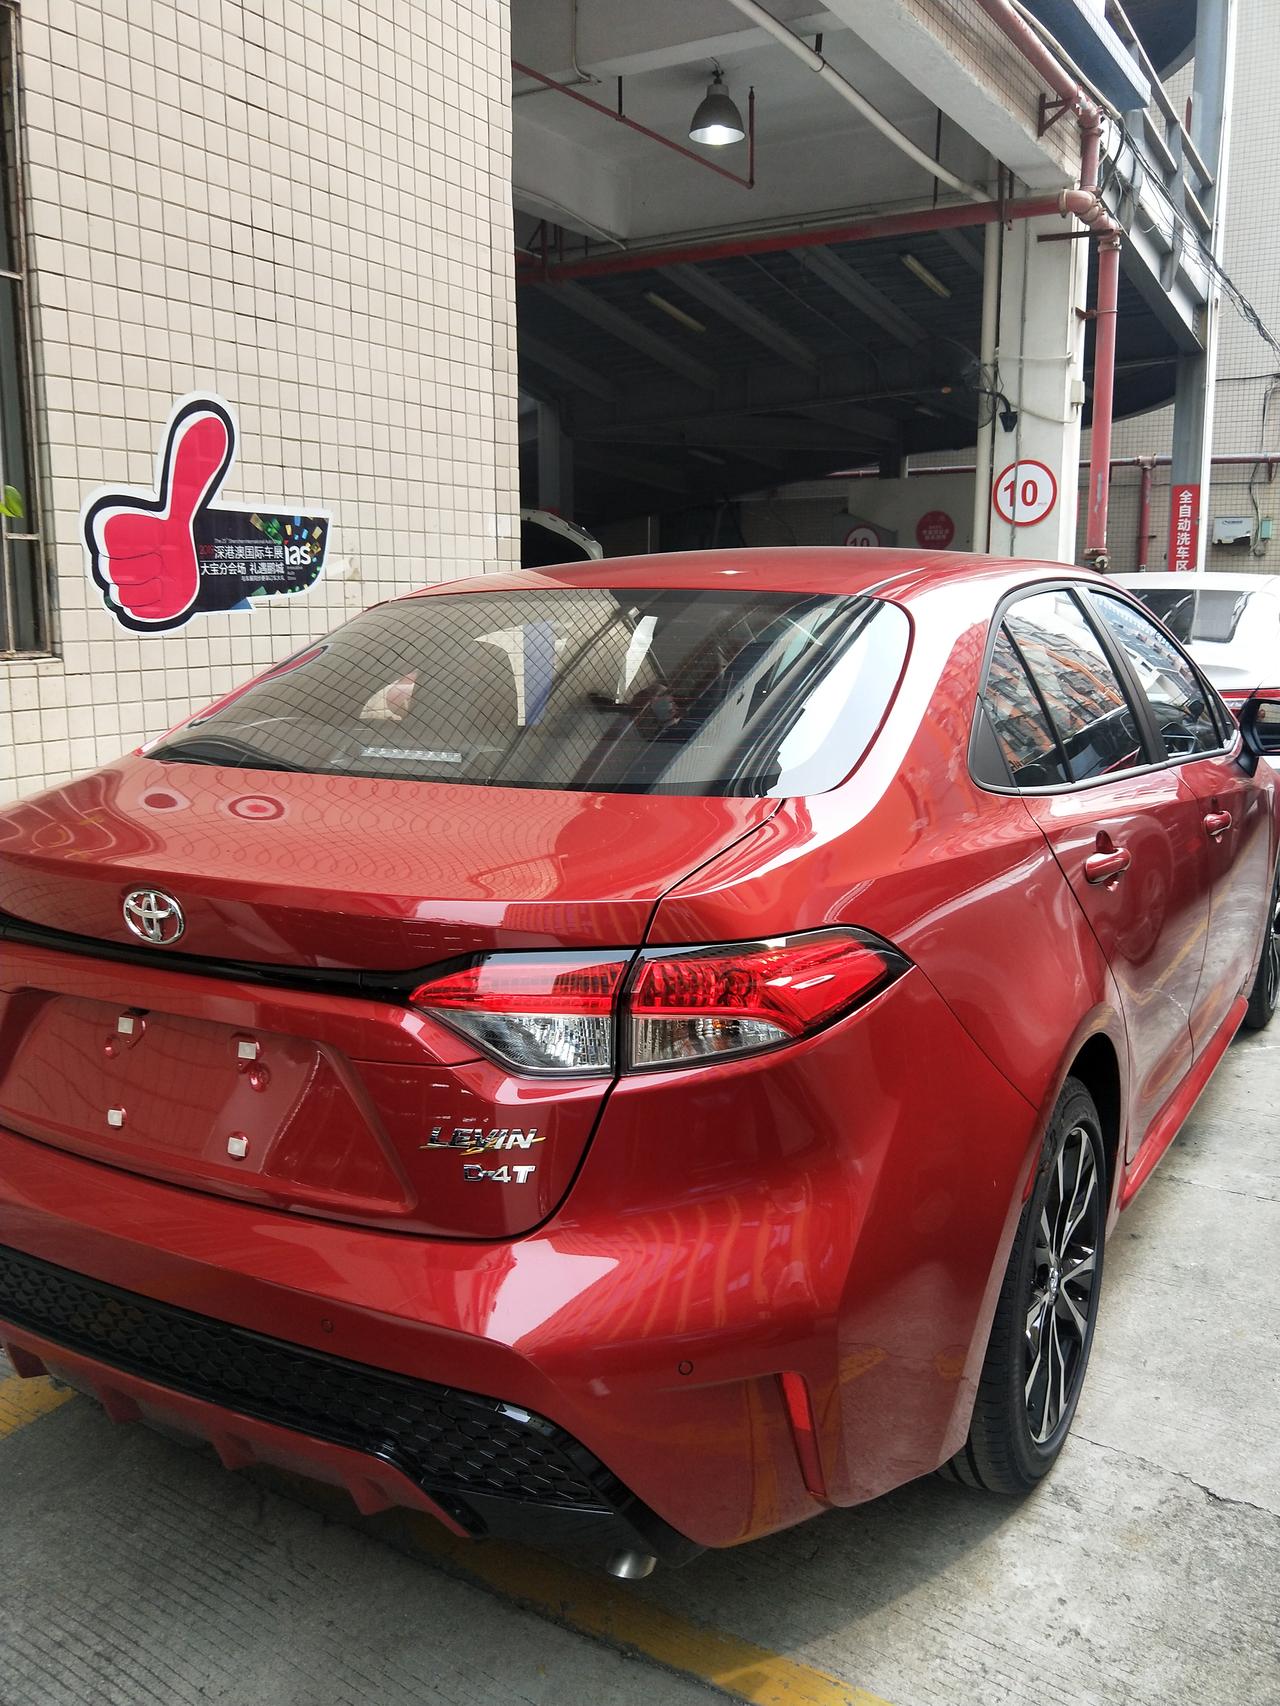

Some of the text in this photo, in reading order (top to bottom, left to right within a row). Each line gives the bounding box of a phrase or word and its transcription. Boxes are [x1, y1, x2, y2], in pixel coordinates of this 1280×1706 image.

[1003, 479, 1038, 507] 10
[1176, 489, 1193, 572] 全自动洗车区
[214, 545, 284, 559] 深港澳国际车展
[201, 562, 247, 575] 大宝分会场
[426, 1127, 538, 1150] LEVIN
[463, 1164, 536, 1183] D-4T
